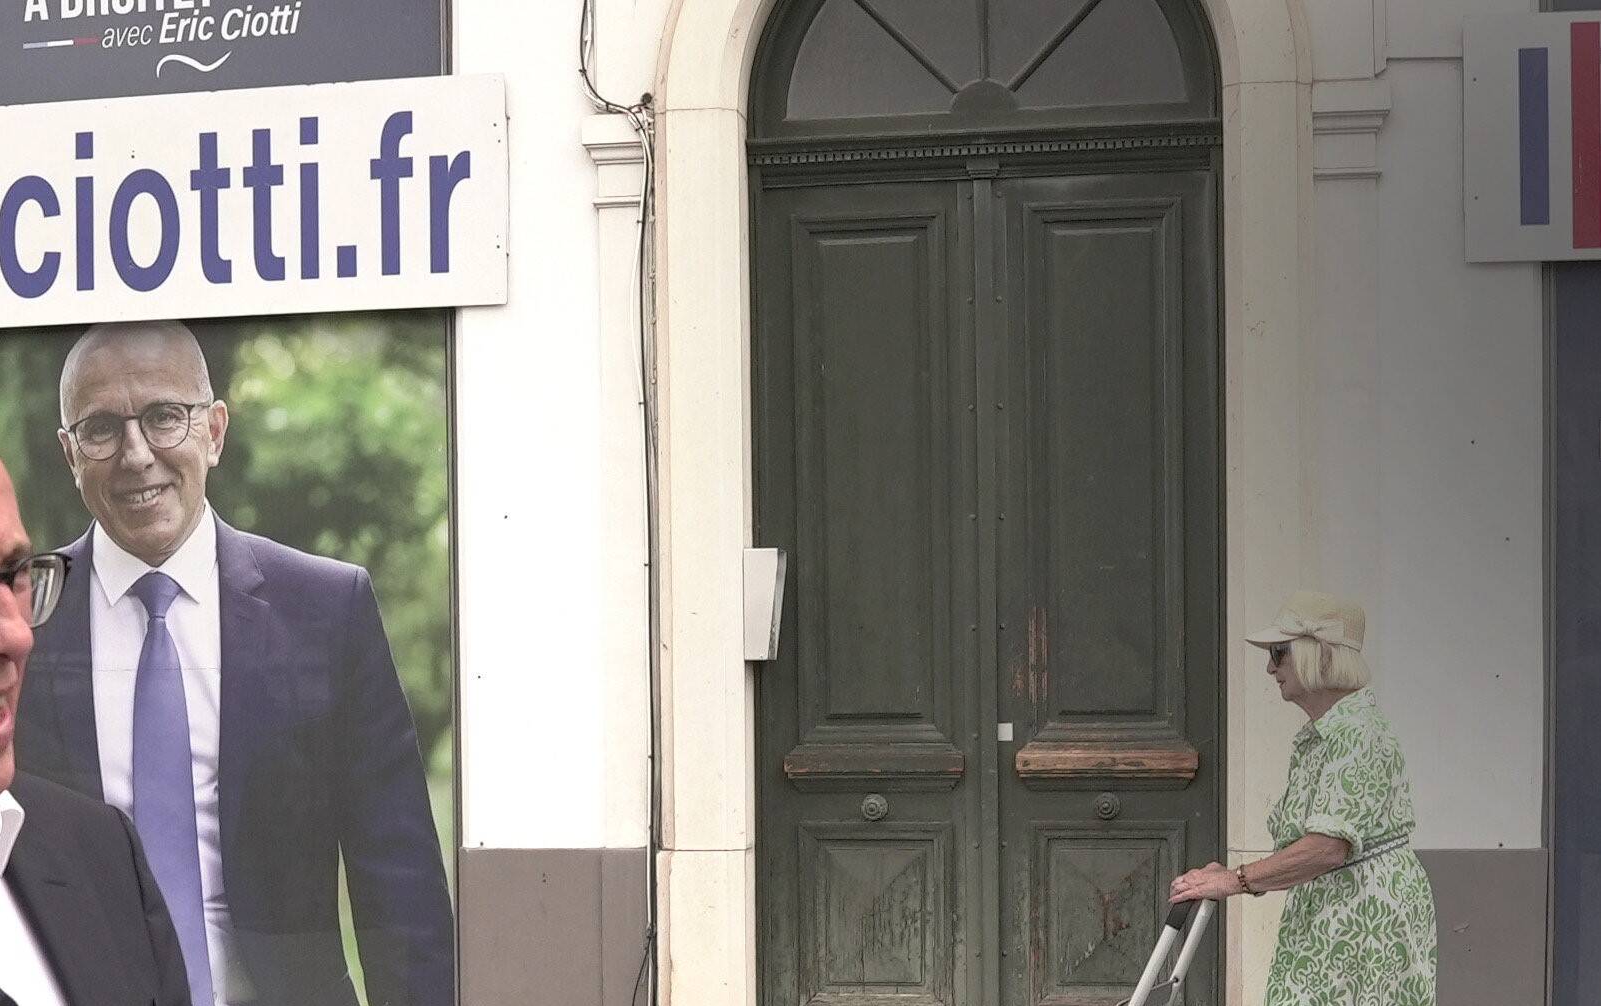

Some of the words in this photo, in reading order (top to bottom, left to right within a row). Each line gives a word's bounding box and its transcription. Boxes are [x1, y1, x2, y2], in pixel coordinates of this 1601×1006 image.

[101, 24, 153, 49] avec
[158, 10, 215, 44] Eric
[220, 2, 302, 42] Ciotti
